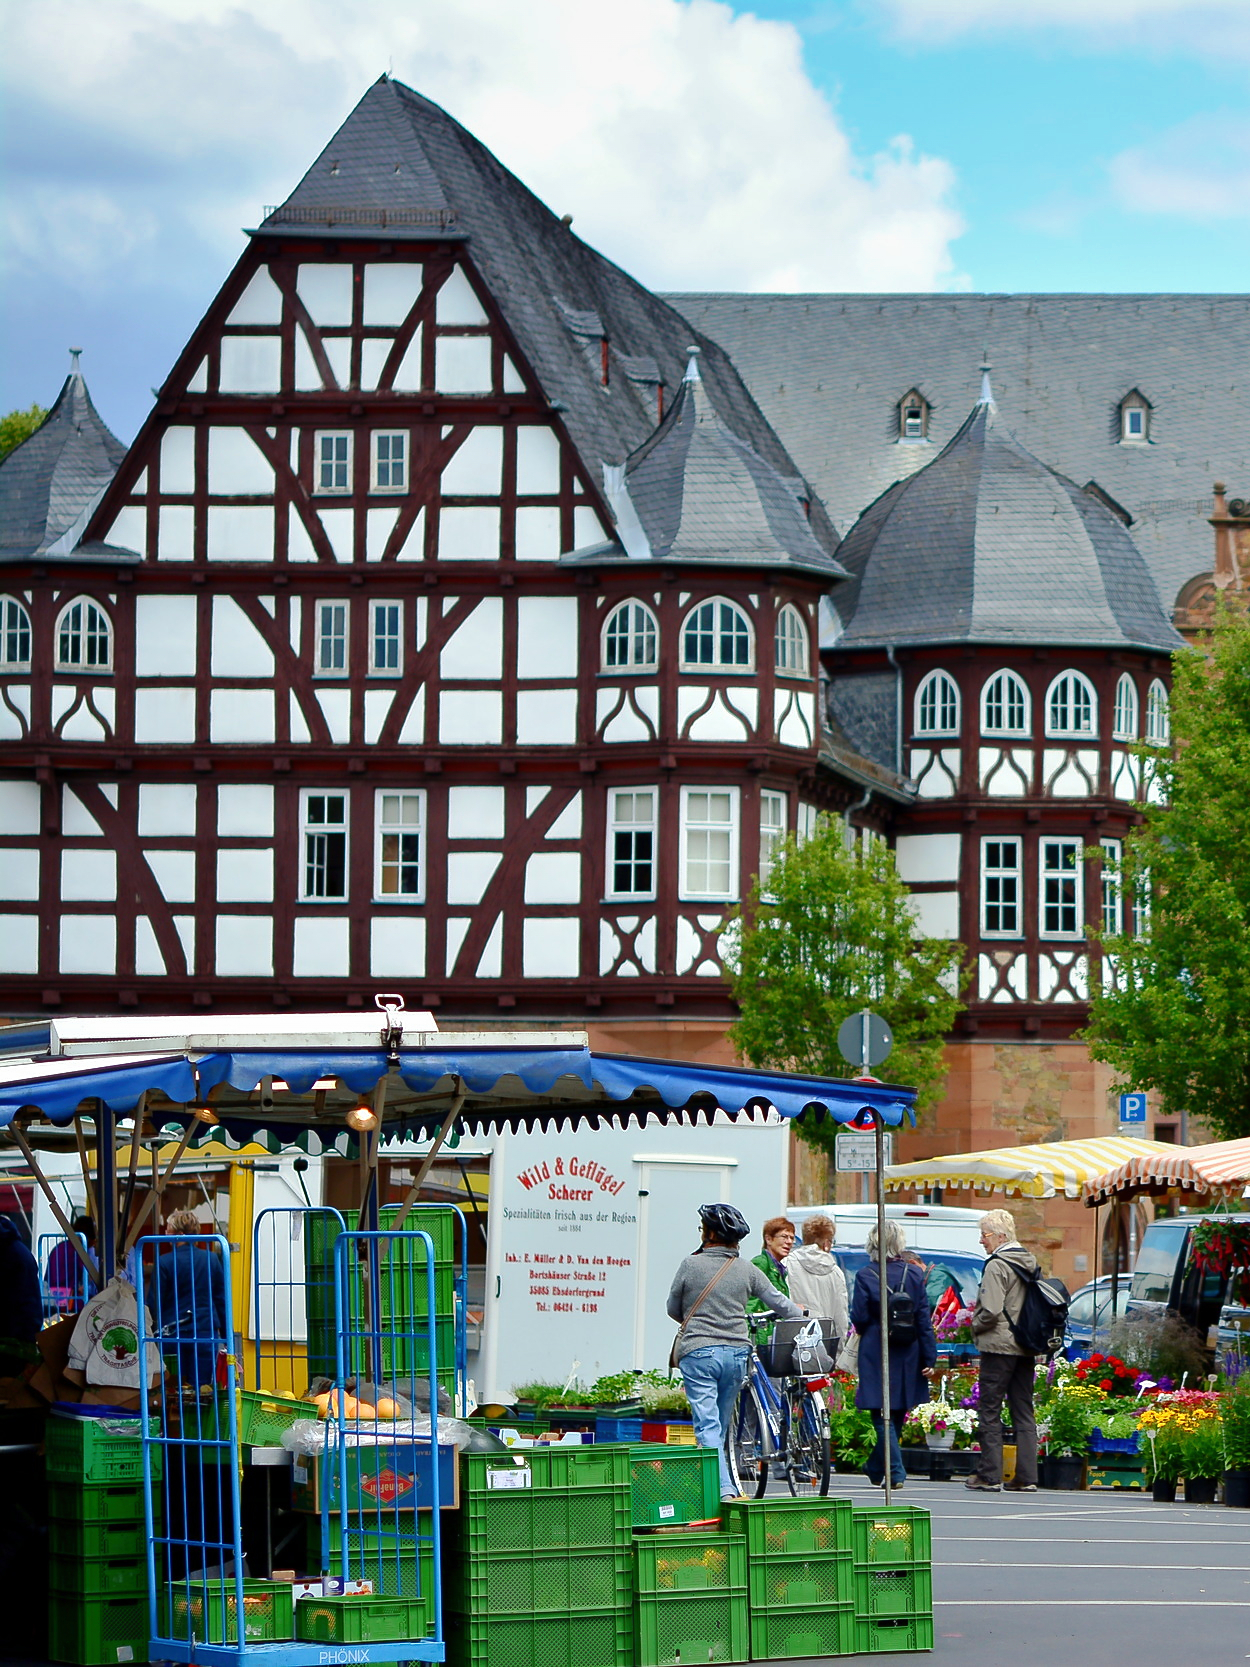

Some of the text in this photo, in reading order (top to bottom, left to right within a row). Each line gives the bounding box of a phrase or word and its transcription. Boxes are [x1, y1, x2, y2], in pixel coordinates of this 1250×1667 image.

[1126, 1097, 1140, 1119] P
[516, 1156, 626, 1196] Wild & Geflügel
[548, 1183, 594, 1201] Scherer
[503, 1207, 637, 1224] Spezialitäten frisch aus der Region
[524, 1253, 532, 1263] E.
[534, 1253, 556, 1264] Müller
[558, 1254, 564, 1264] &
[566, 1254, 575, 1264] D.
[592, 1256, 604, 1265] den
[573, 1270, 596, 1281] Straße
[552, 1286, 606, 1299] Ebsdorfergrund
[536, 1302, 551, 1312] Tel.:
[319, 1649, 370, 1664] PHÖNIX
